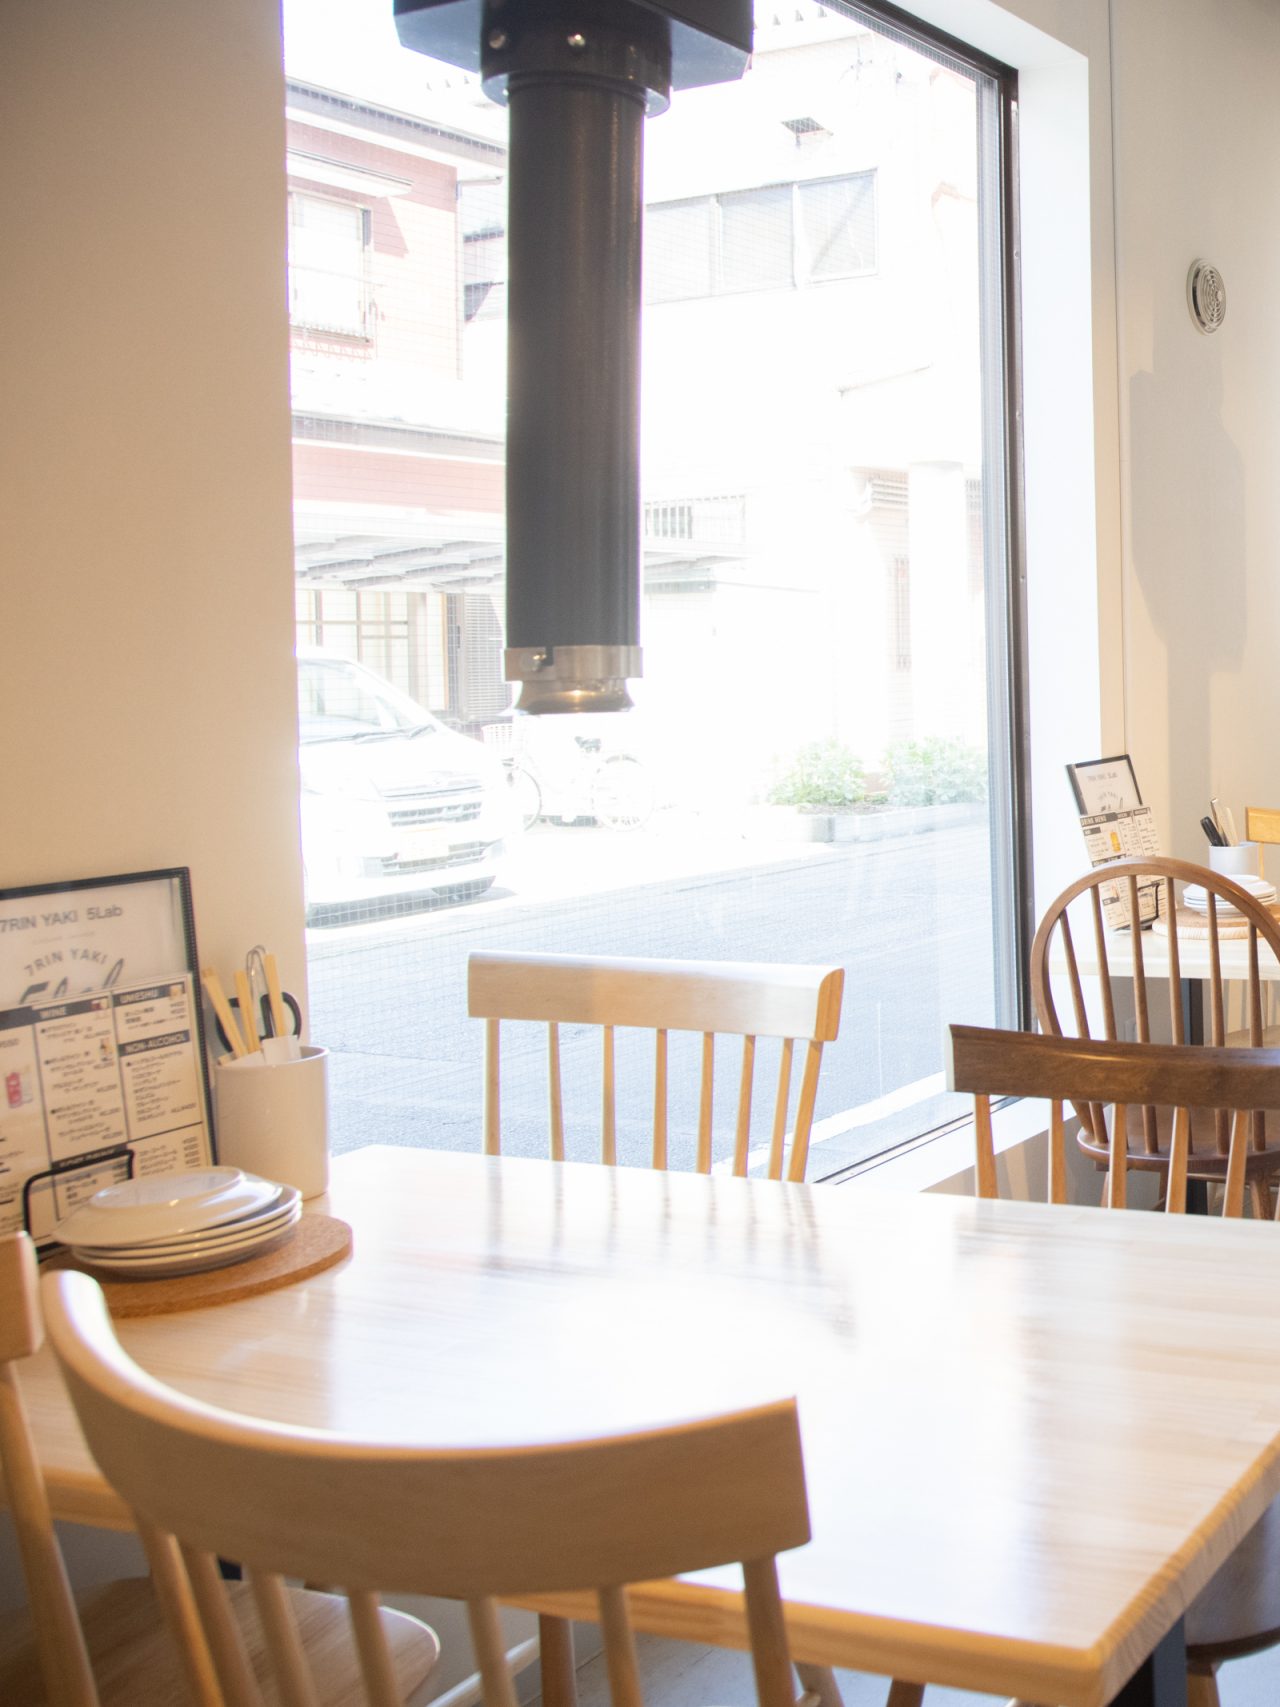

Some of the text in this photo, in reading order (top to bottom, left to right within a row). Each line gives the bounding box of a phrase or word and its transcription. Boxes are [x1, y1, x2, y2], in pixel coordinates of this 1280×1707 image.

[41, 910, 79, 926] YAKI
[87, 904, 124, 921] 5Lab
[24, 948, 109, 976] 7RIN YAKI
